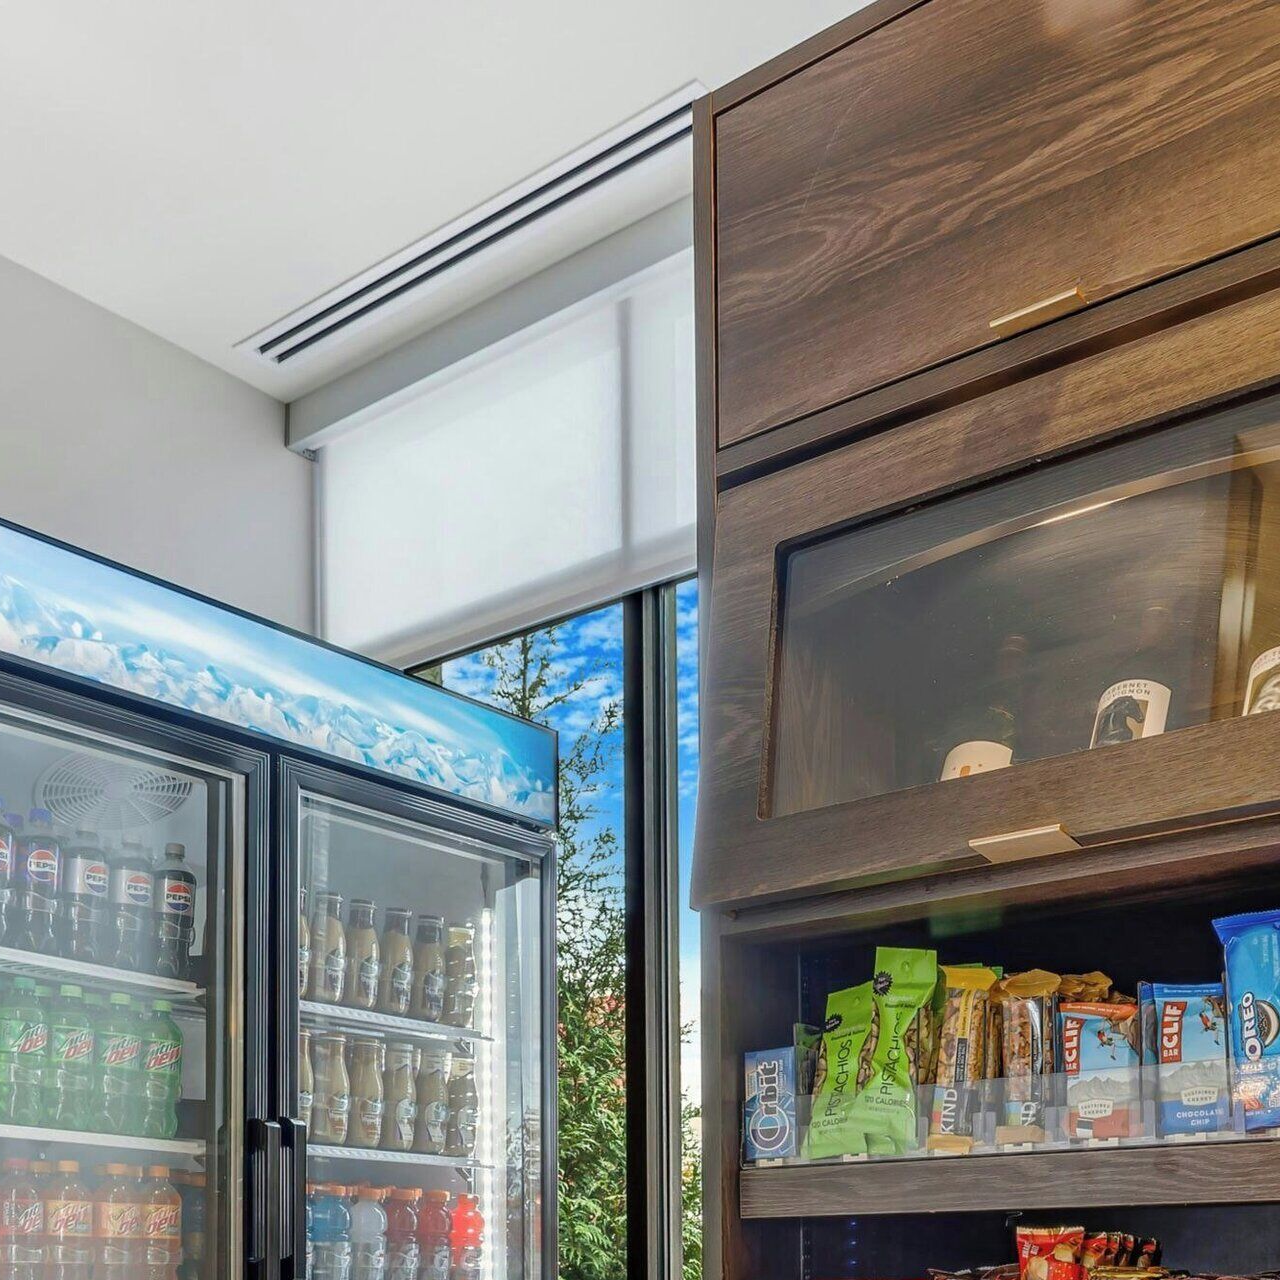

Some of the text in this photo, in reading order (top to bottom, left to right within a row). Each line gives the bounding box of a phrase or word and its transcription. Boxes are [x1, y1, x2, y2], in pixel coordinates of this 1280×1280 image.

[1065, 1020, 1080, 1061] CLIF
[1162, 1003, 1184, 1048] CLIF
[1242, 991, 1263, 1061] OREO
[825, 1039, 852, 1117] PISTACHIOS
[941, 1088, 957, 1134] KIND
[1176, 1110, 1223, 1119] CHOCOLATE
[1190, 1118, 1211, 1126] CHIP
